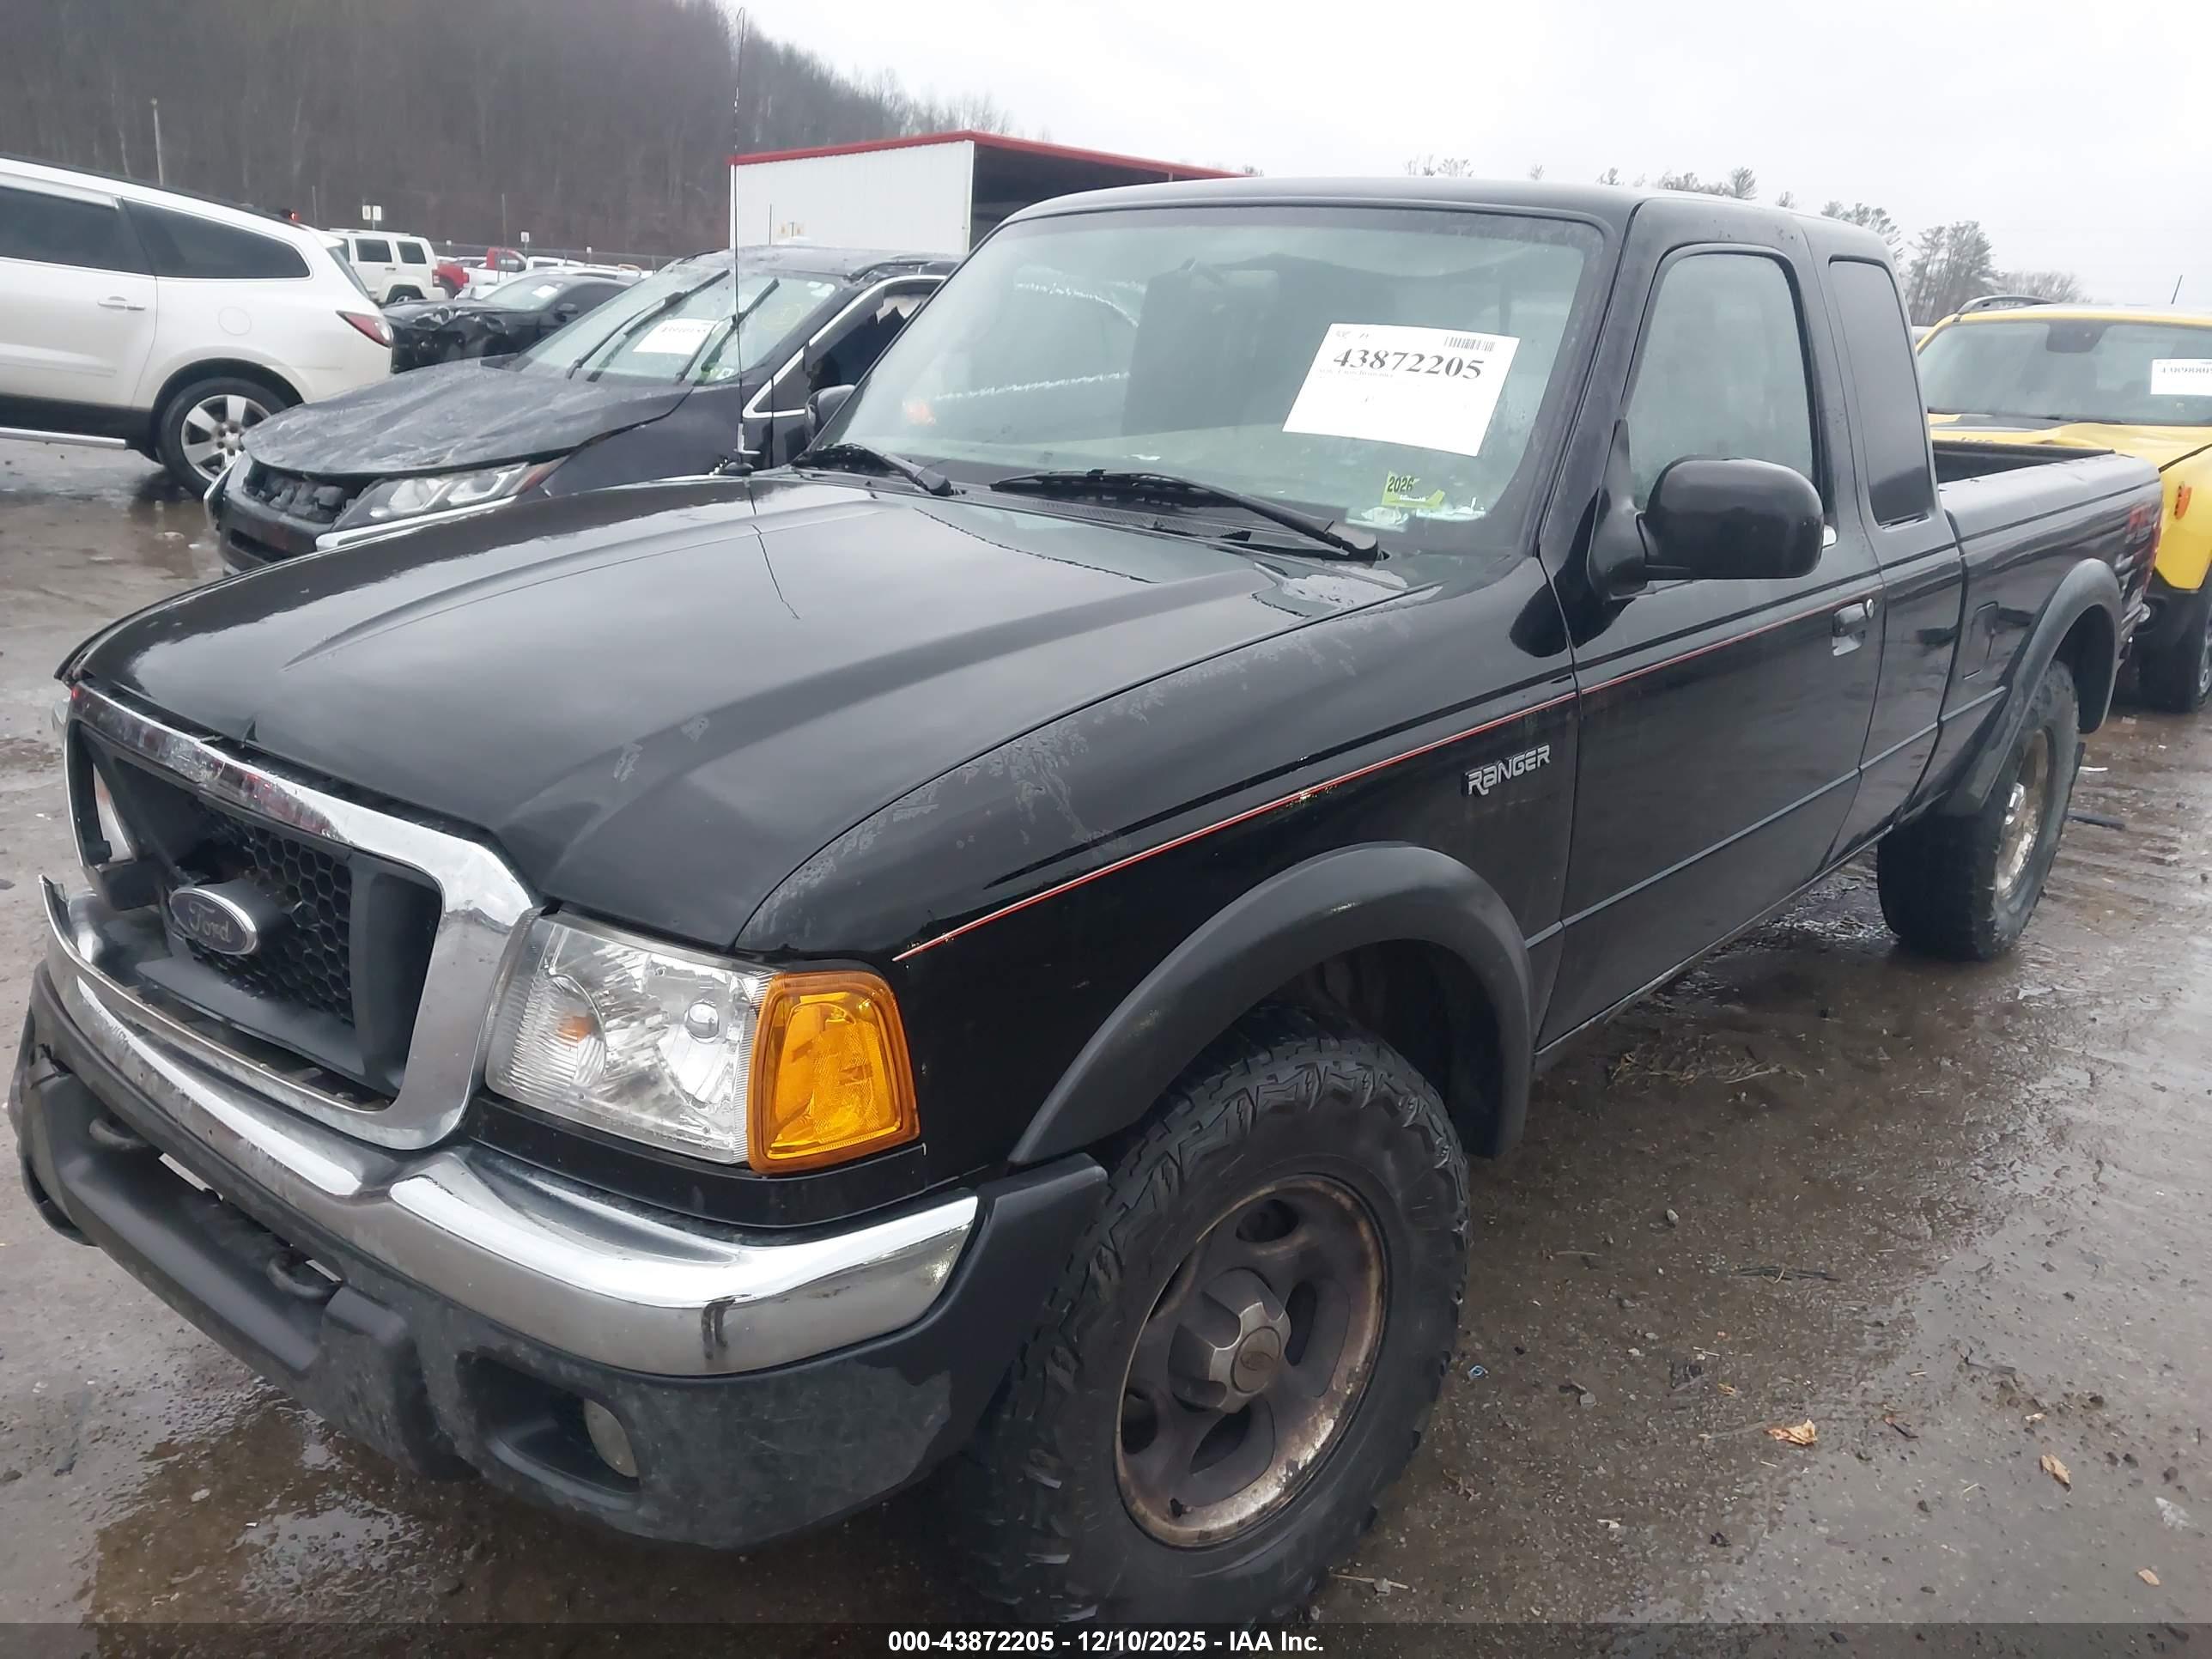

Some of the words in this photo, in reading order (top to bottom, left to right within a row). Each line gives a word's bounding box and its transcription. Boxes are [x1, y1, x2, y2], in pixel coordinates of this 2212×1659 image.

[1333, 348, 1485, 380] 43872205
[1386, 475, 1415, 493] 2026
[188, 900, 233, 944] Ford
